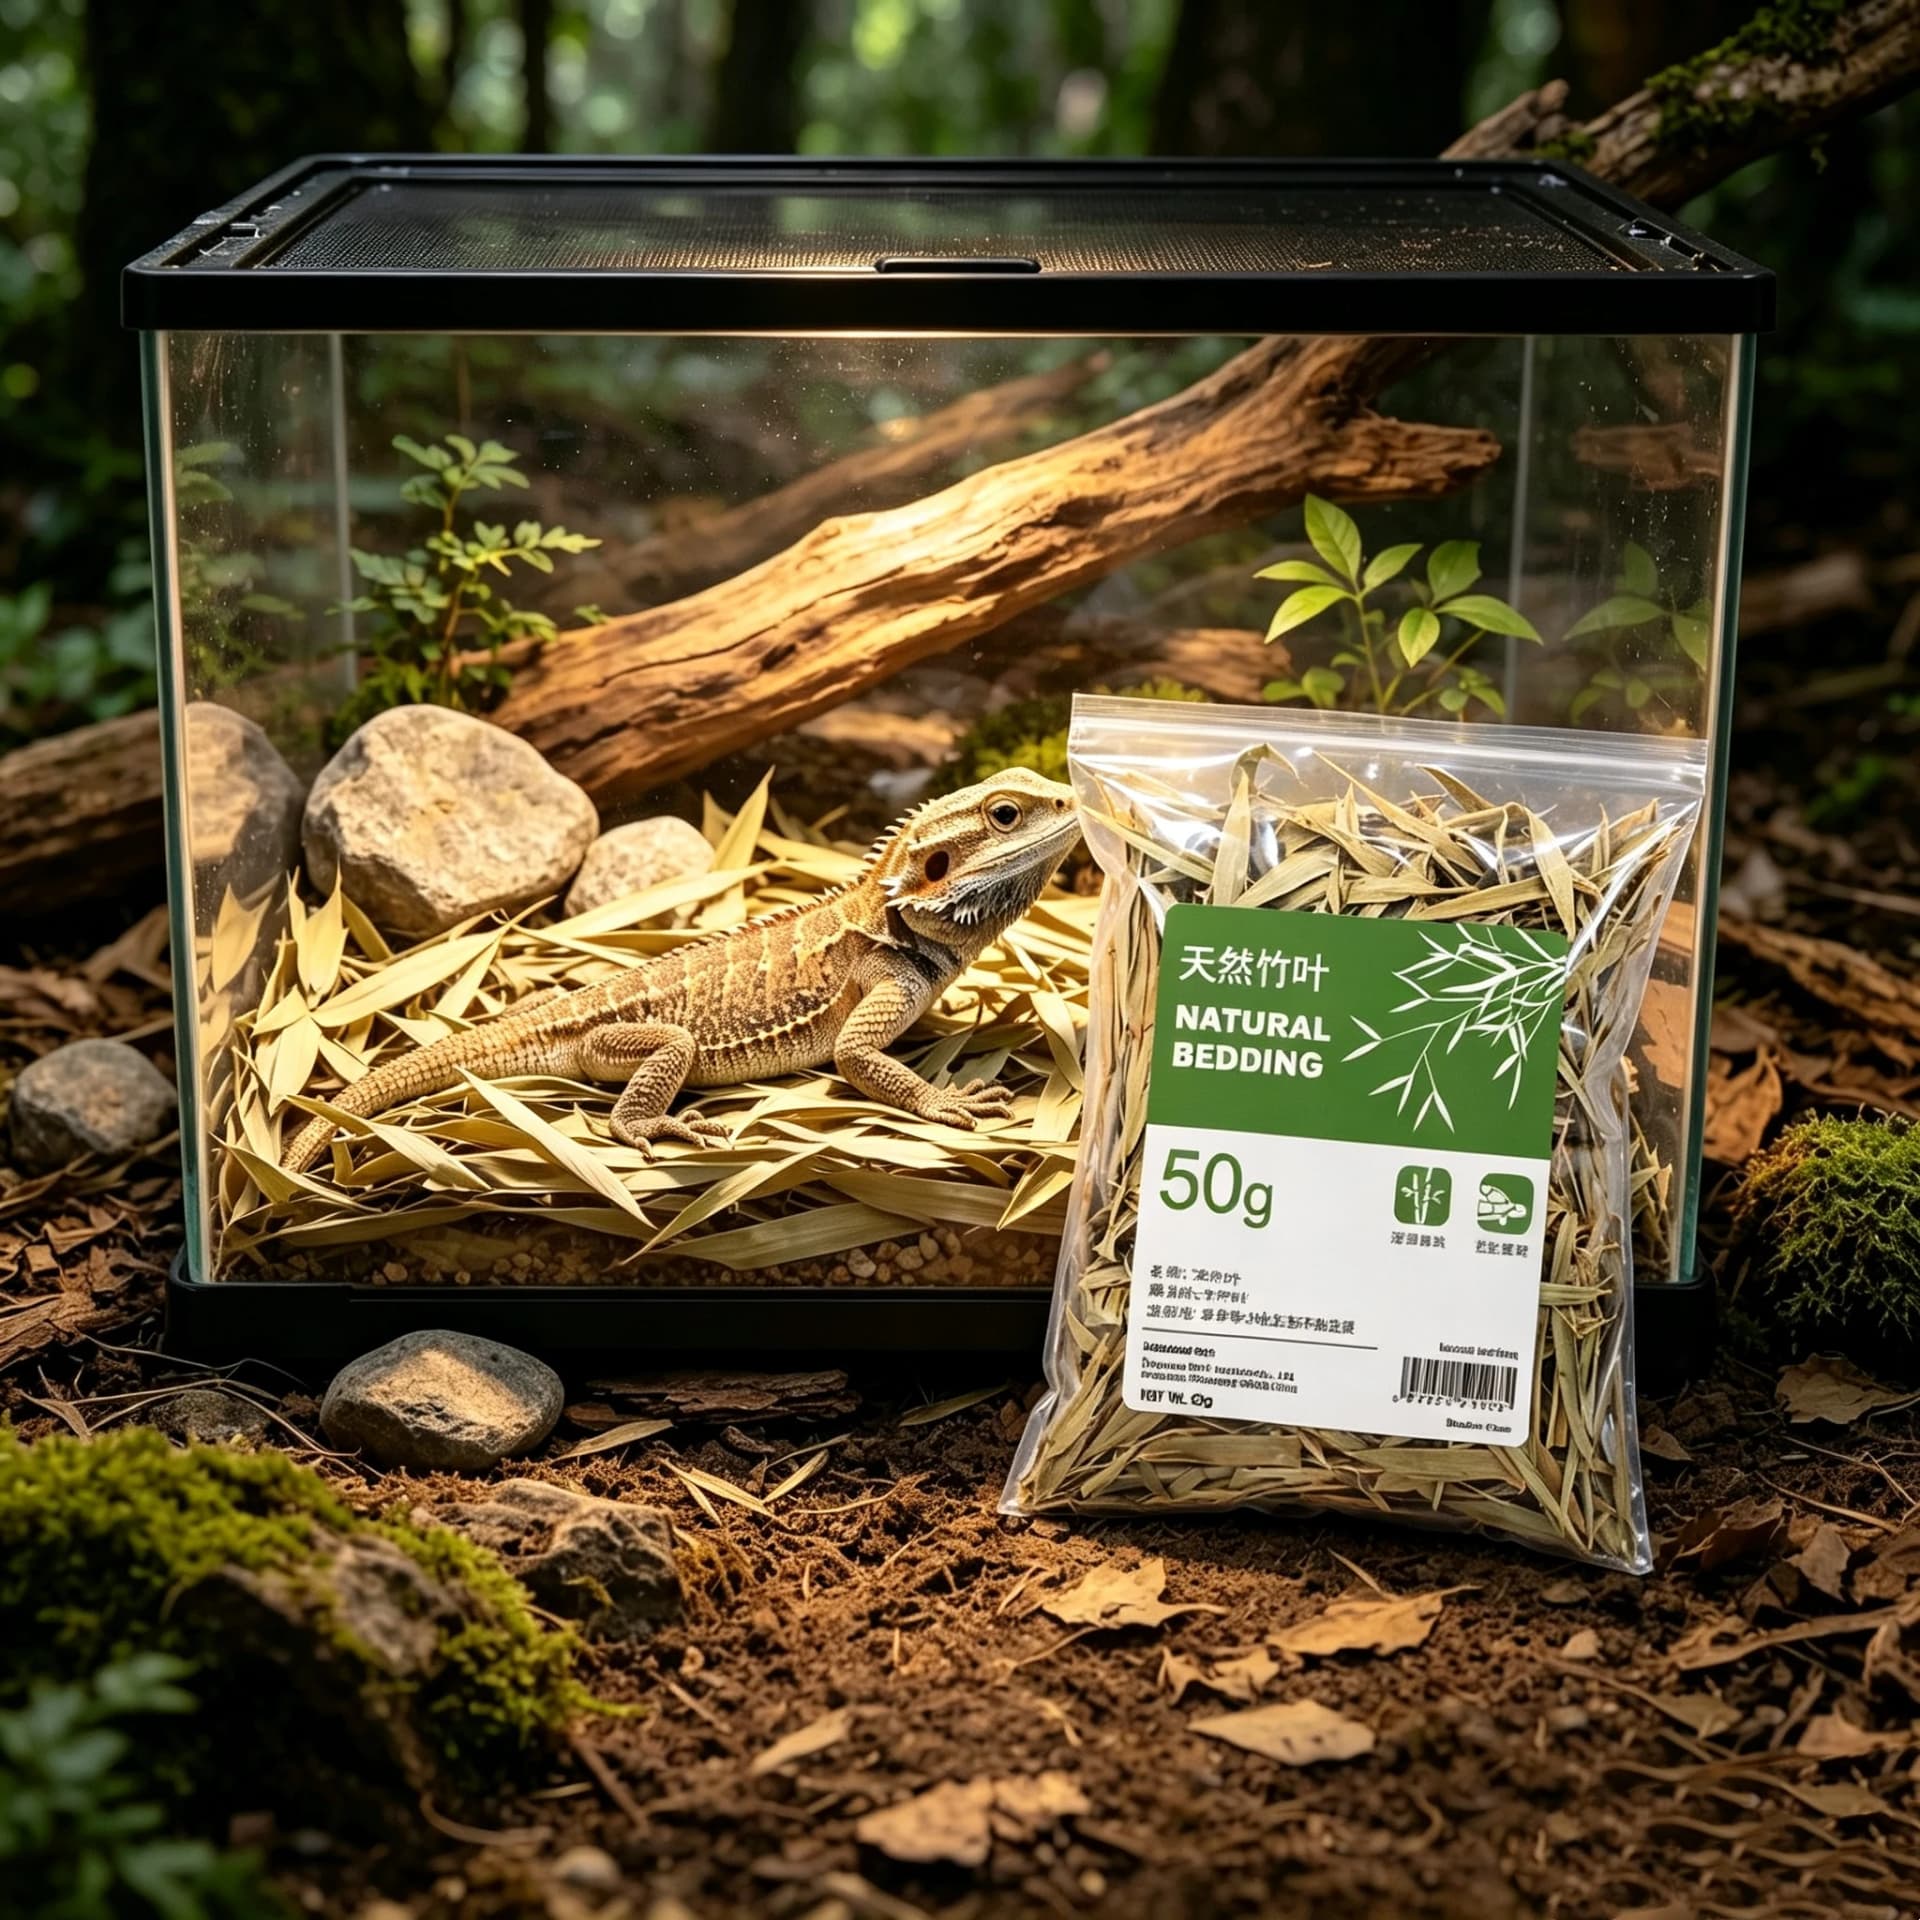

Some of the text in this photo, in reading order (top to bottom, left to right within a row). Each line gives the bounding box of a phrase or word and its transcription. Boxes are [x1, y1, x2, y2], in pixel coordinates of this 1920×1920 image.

[1178, 945, 1330, 992] 天然竹叶
[1175, 1004, 1331, 1042] NATURAL
[1172, 1041, 1324, 1078] BEDDING
[1159, 1148, 1273, 1229] 50g
